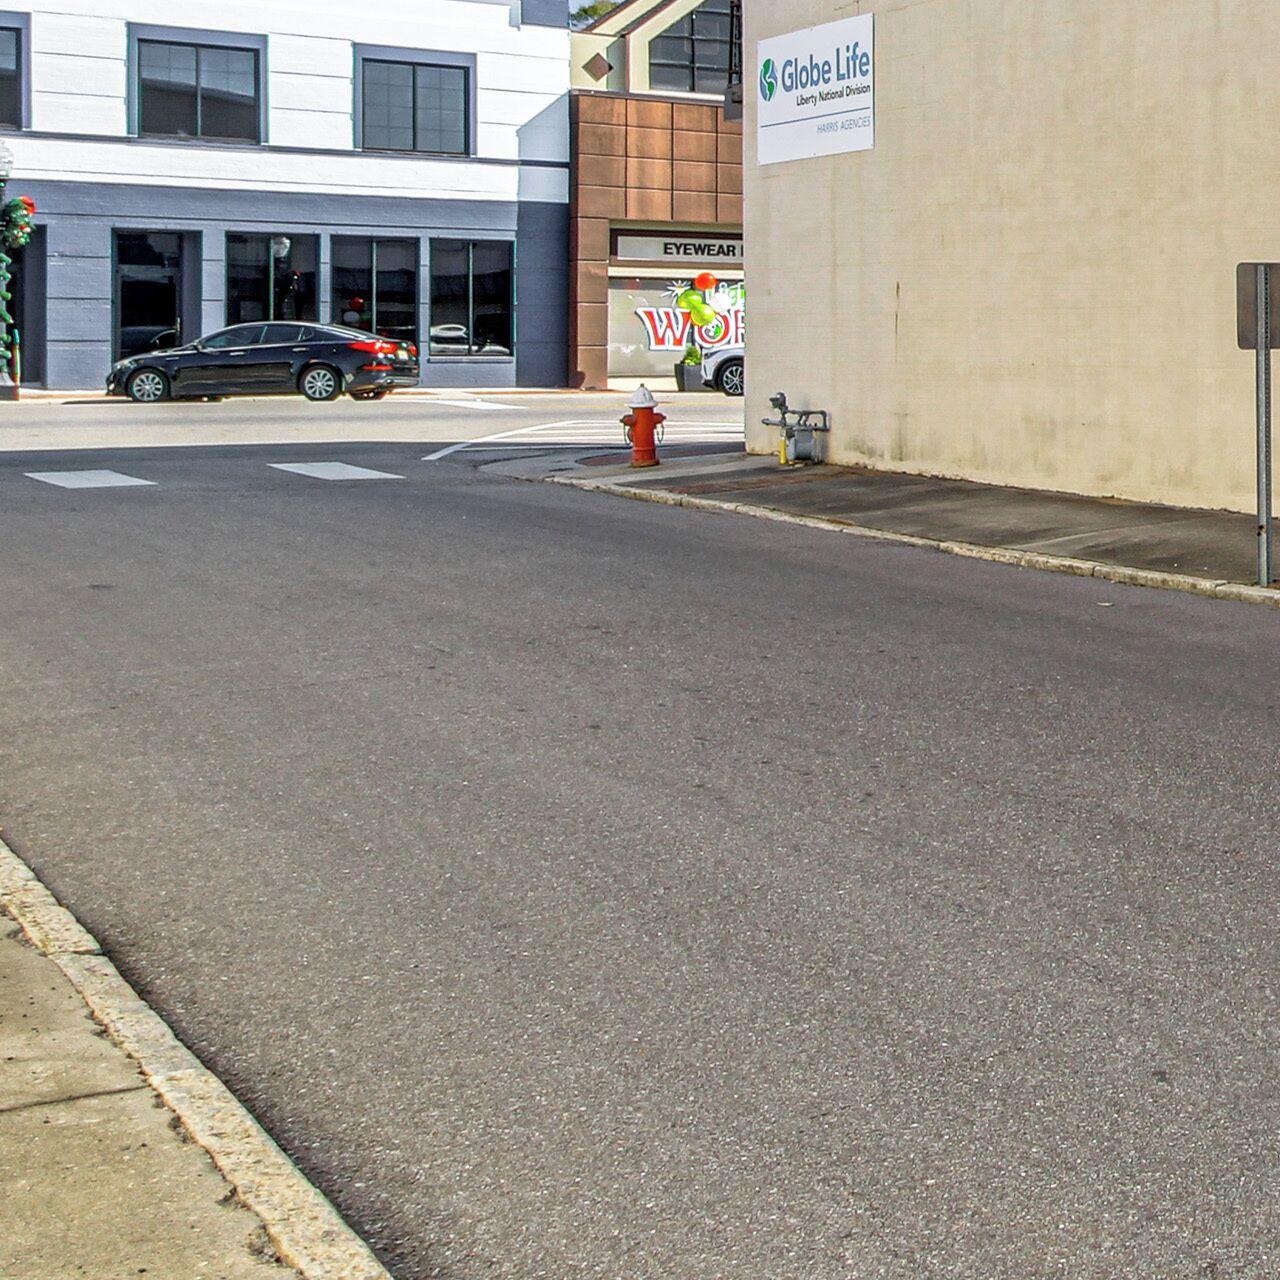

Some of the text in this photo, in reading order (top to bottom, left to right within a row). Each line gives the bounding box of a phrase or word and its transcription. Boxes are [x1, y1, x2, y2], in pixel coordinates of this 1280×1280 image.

[782, 41, 870, 93] Globe Life
[796, 83, 870, 107] Liberty National Division
[840, 116, 871, 130] AGENCIES
[664, 242, 736, 257] EYEWEAR
